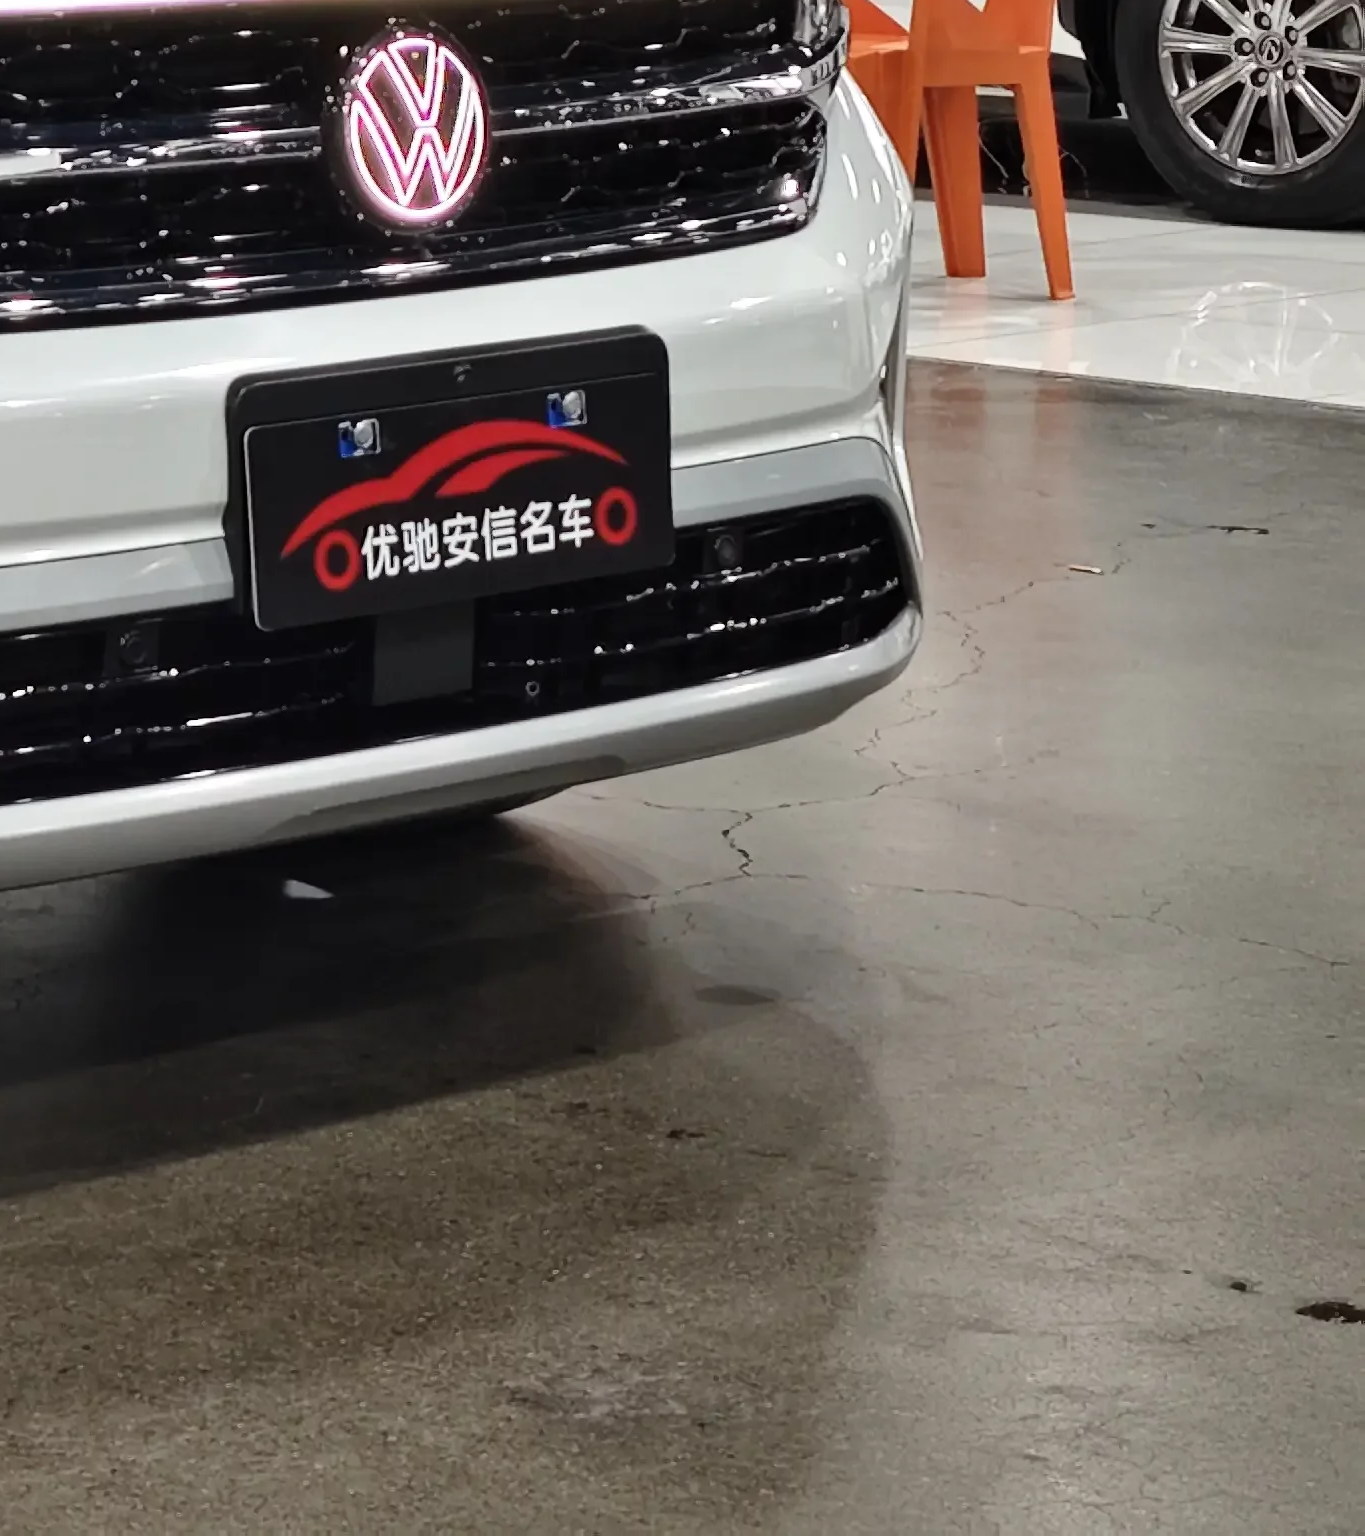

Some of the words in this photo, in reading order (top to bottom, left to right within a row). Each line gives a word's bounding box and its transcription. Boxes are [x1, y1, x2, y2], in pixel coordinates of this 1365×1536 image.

[361, 494, 596, 581] 优驰安信名车
